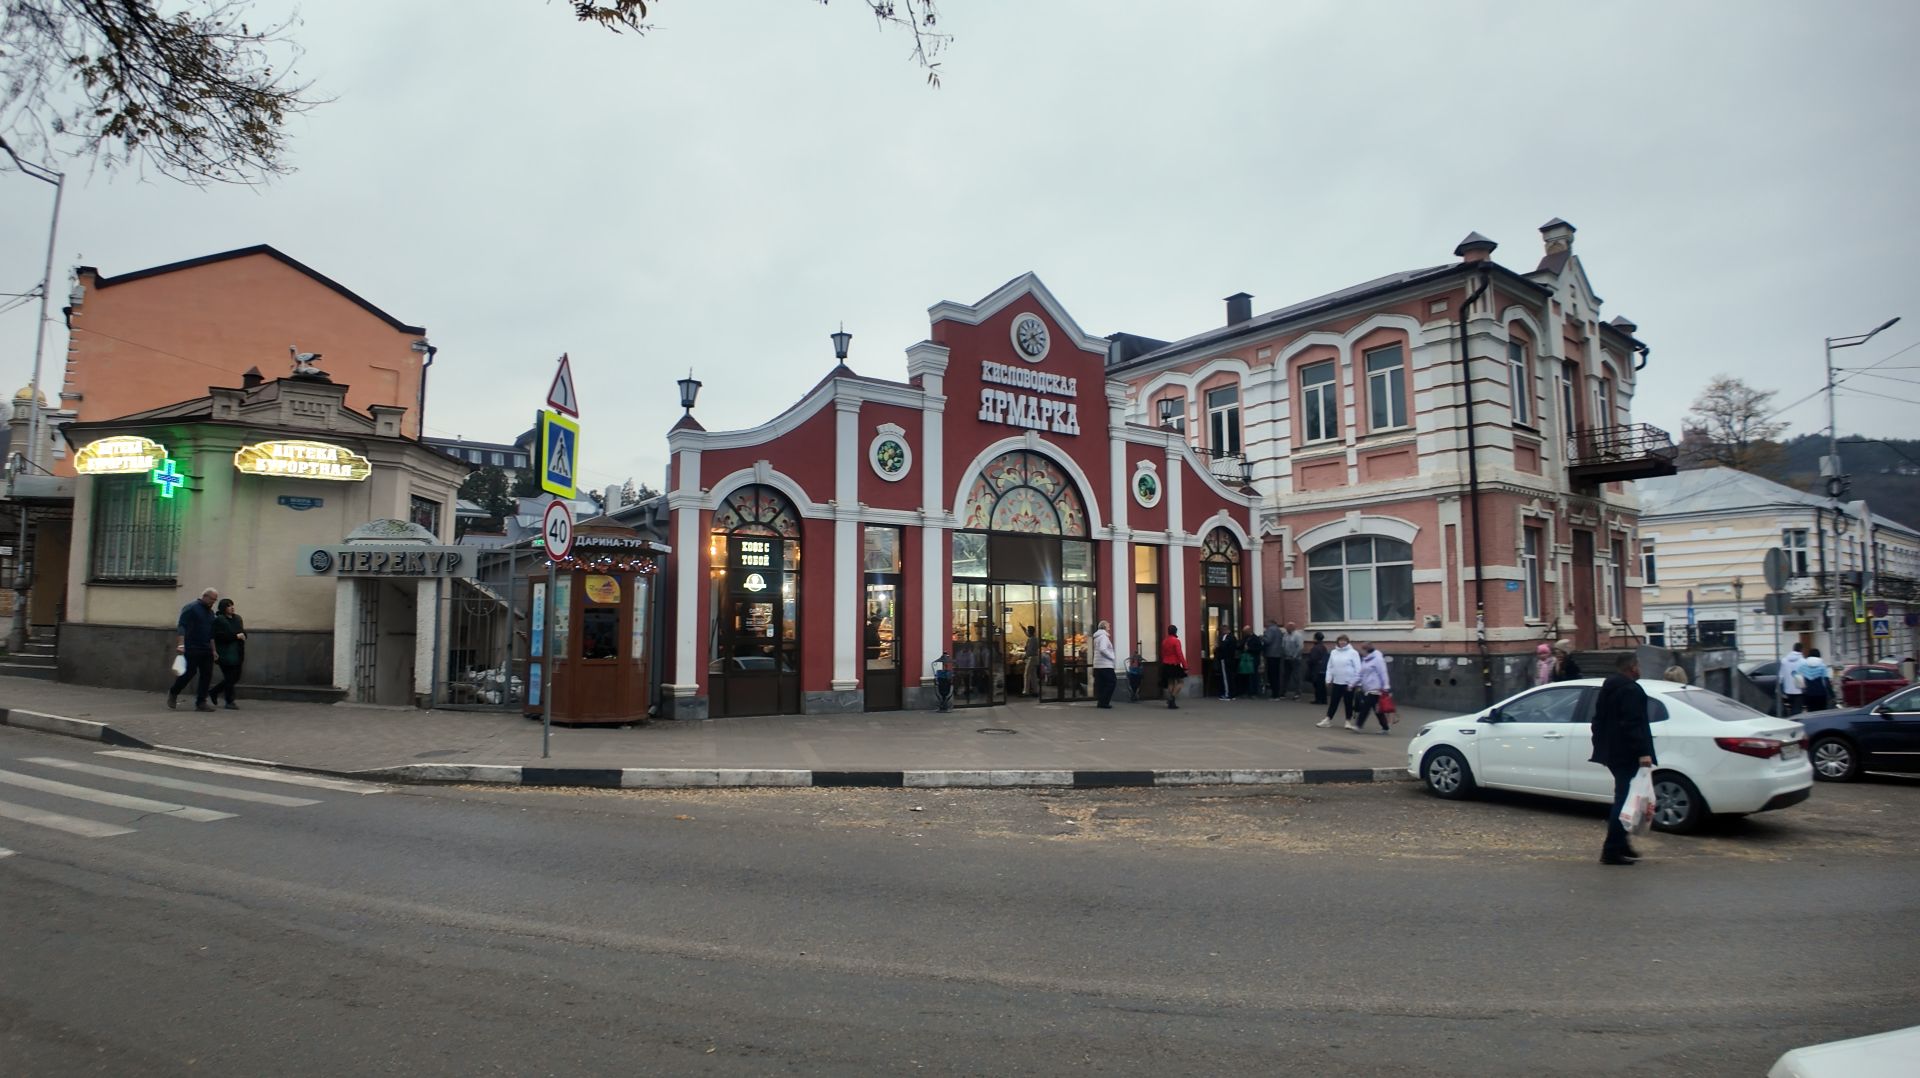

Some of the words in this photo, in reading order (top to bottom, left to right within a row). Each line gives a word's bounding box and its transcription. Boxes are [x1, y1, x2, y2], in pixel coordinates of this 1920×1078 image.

[981, 360, 1077, 397] КИСЛОВОДСКАЯ
[978, 388, 1080, 435] ЯРМАРКА
[272, 444, 338, 461] АПТЕКА
[255, 458, 353, 477] КУРОРТНАЯ
[548, 518, 567, 544] 40
[575, 535, 642, 548] ДАРИНА-ТУР
[337, 551, 461, 573] ПЕРЕКУР
[741, 554, 770, 567] ТОБОЙ
